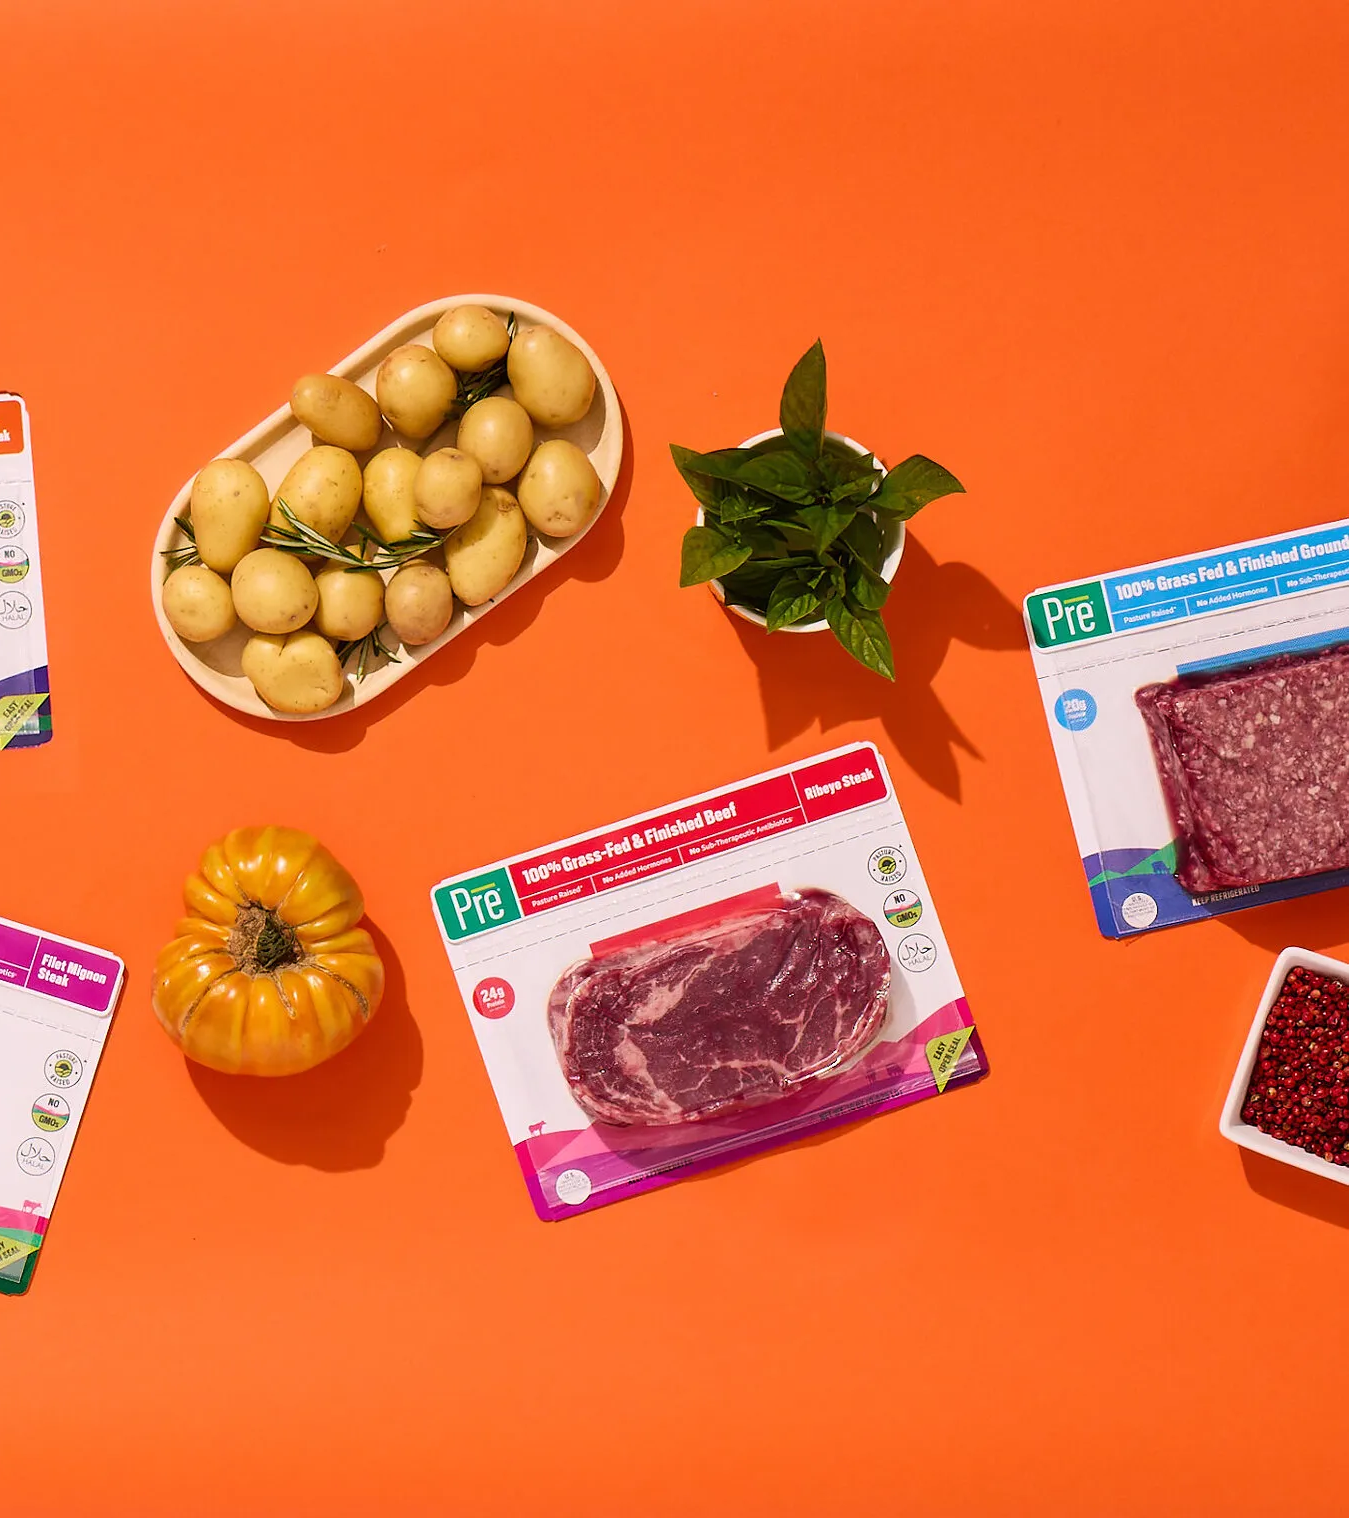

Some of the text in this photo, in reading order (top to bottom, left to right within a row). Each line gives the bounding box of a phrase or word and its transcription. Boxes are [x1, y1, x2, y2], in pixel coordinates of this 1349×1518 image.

[4, 550, 15, 558] NO
[1, 568, 22, 577] GMOs
[1114, 534, 1349, 600] 100% Grass Fed & Finished Ground
[1286, 578, 1298, 587] No
[1195, 585, 1268, 607] No Added Hormones
[1123, 611, 1149, 624] Pasture
[803, 766, 874, 802] Ribeye Steak
[521, 801, 738, 885] 100% Grass-Fed & Finished Beef
[688, 845, 700, 856] No
[700, 827, 755, 852] Sub-Therapeutic
[871, 846, 895, 861] PASTURE
[601, 855, 672, 884] No Added Hormones
[531, 893, 558, 908] Pasture
[893, 893, 906, 904] NO
[1210, 884, 1260, 902] REFRIGERATED
[895, 909, 917, 923] GMOs
[36, 966, 70, 987] Steak
[40, 953, 108, 987] Filet Mignon
[479, 983, 505, 1004] 24g
[933, 1041, 946, 1059] EASY
[939, 1036, 961, 1072] OPEN SEAL
[47, 1098, 60, 1108] NO
[38, 1114, 59, 1128] GMOs
